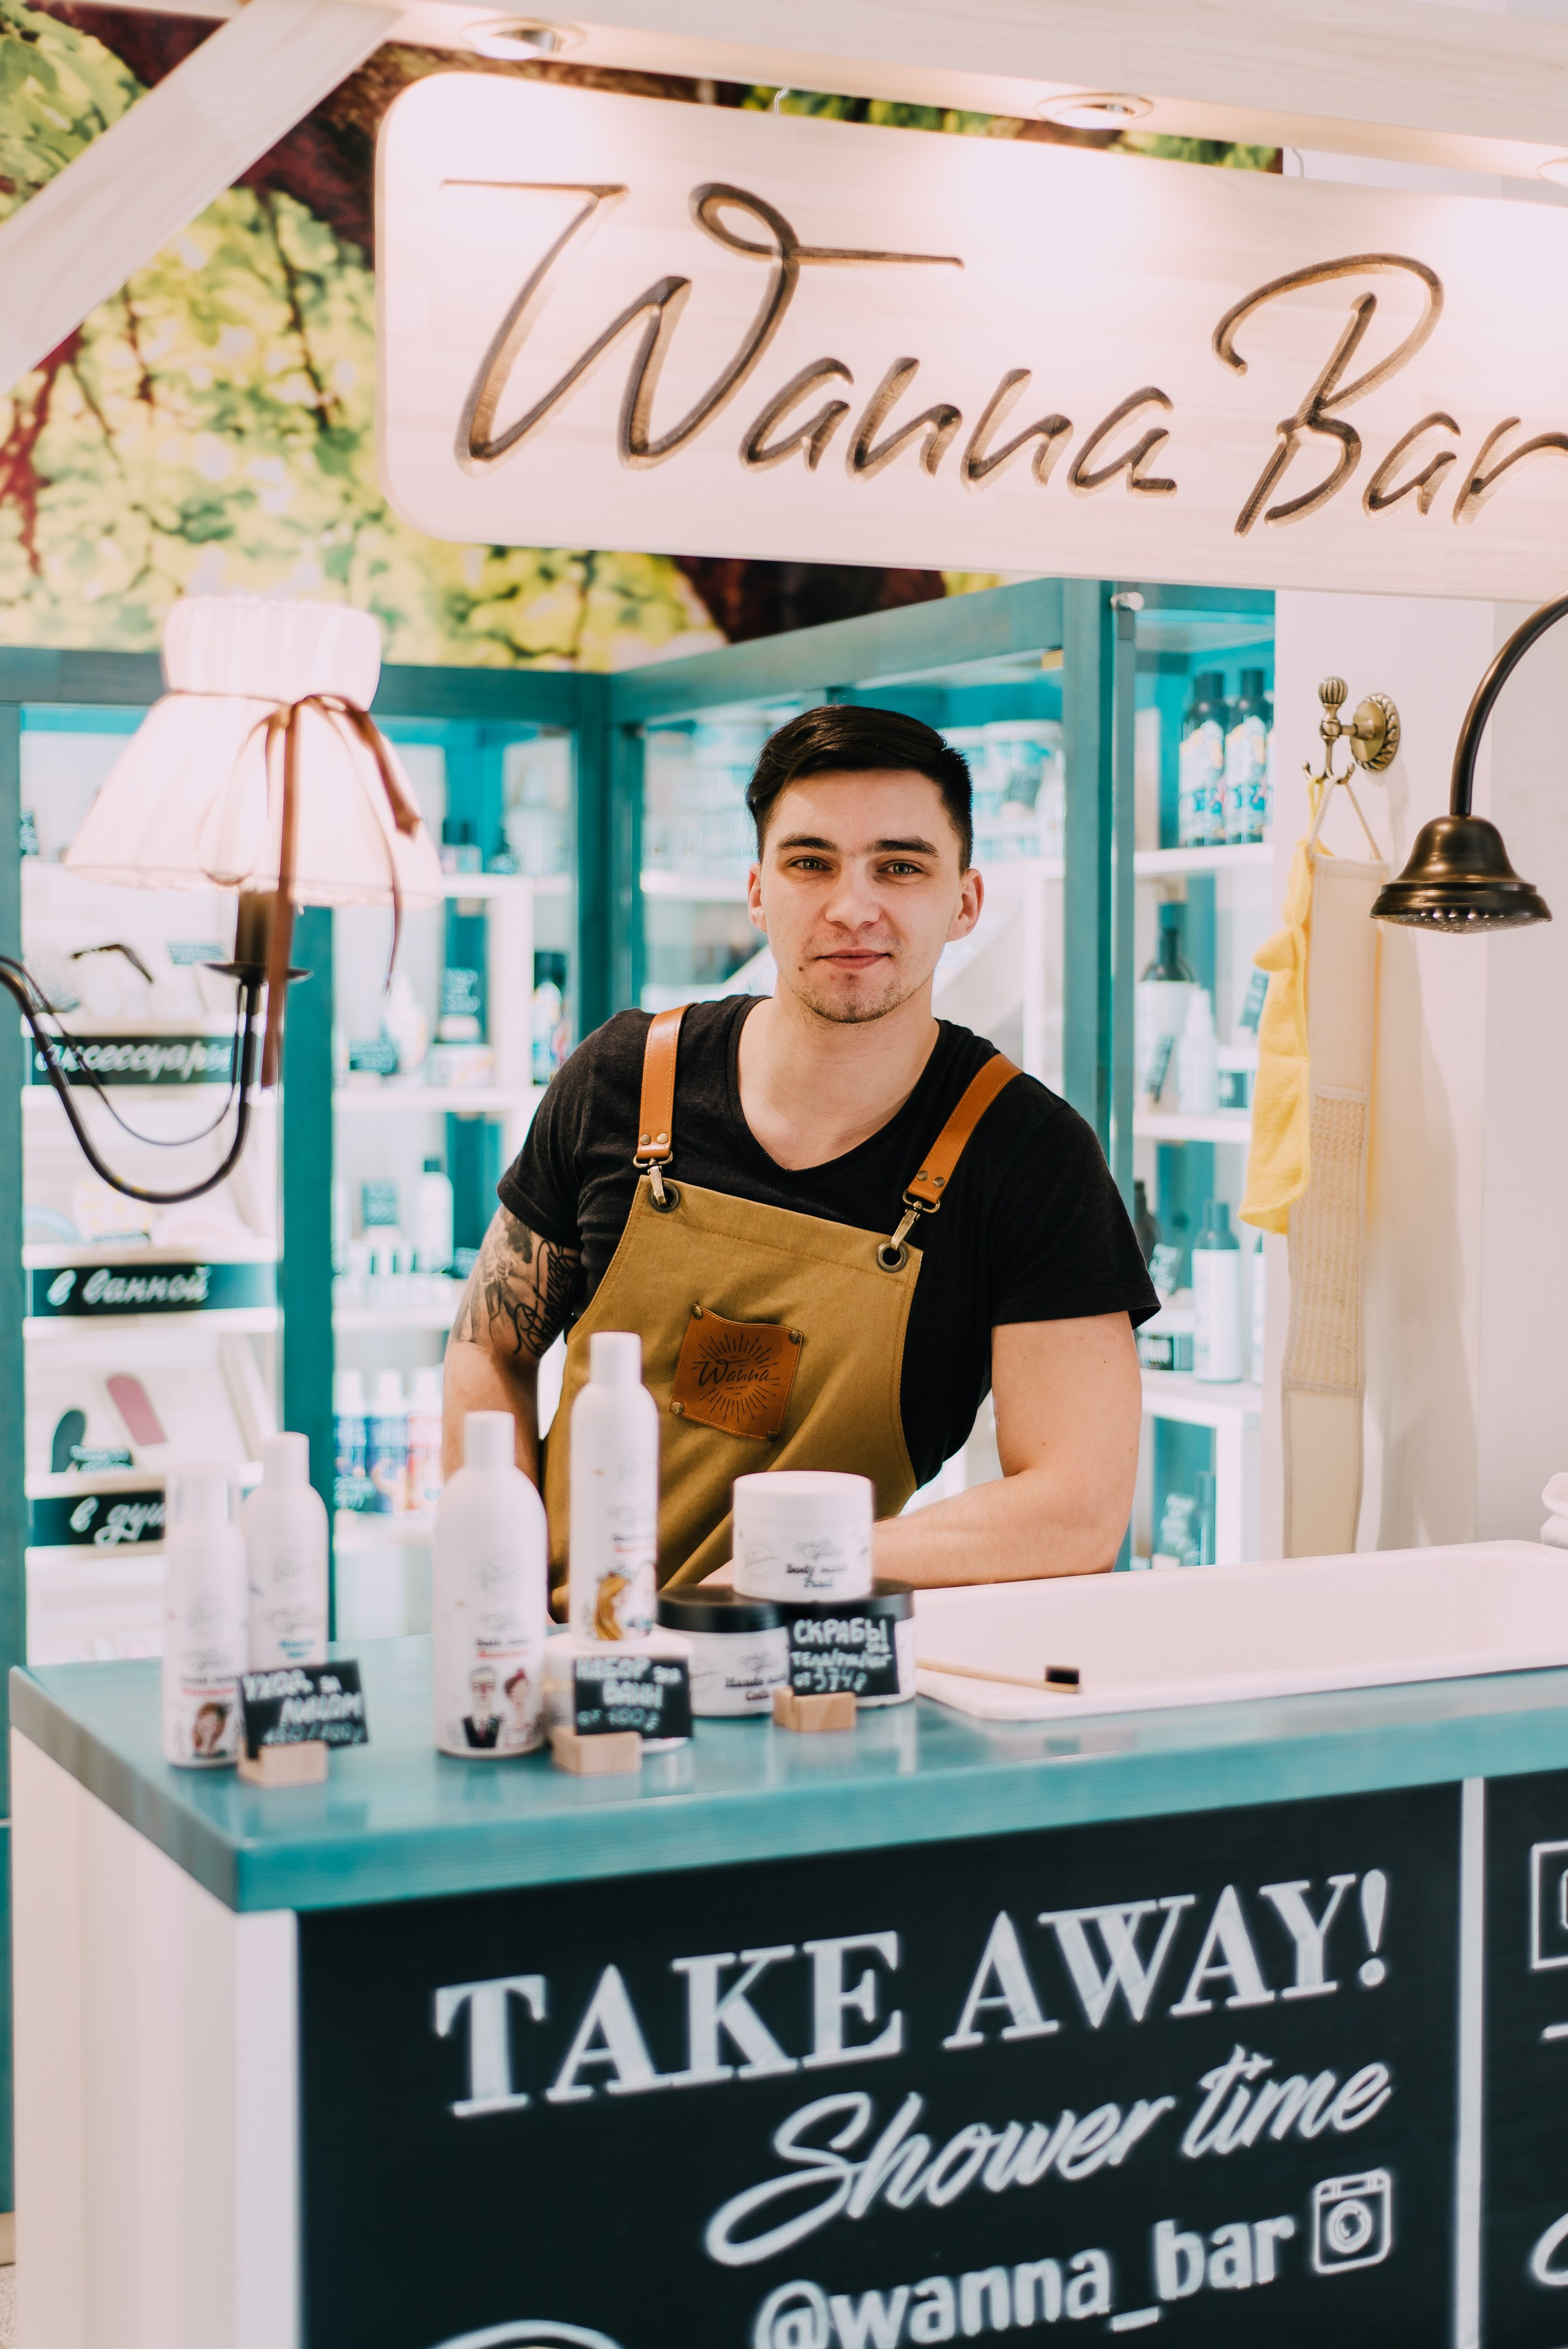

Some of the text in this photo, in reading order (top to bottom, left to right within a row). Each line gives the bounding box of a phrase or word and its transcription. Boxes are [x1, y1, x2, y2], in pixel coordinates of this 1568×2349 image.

[440, 179, 1568, 539] Wanna Bar
[693, 1359, 779, 1387] Wanna
[793, 1617, 888, 1645] СКРАБЫ
[435, 1868, 1387, 2118] TAKE AWAY!
[705, 2043, 1392, 2267] Shower time
[753, 2215, 1297, 2349] @wanna_bar
